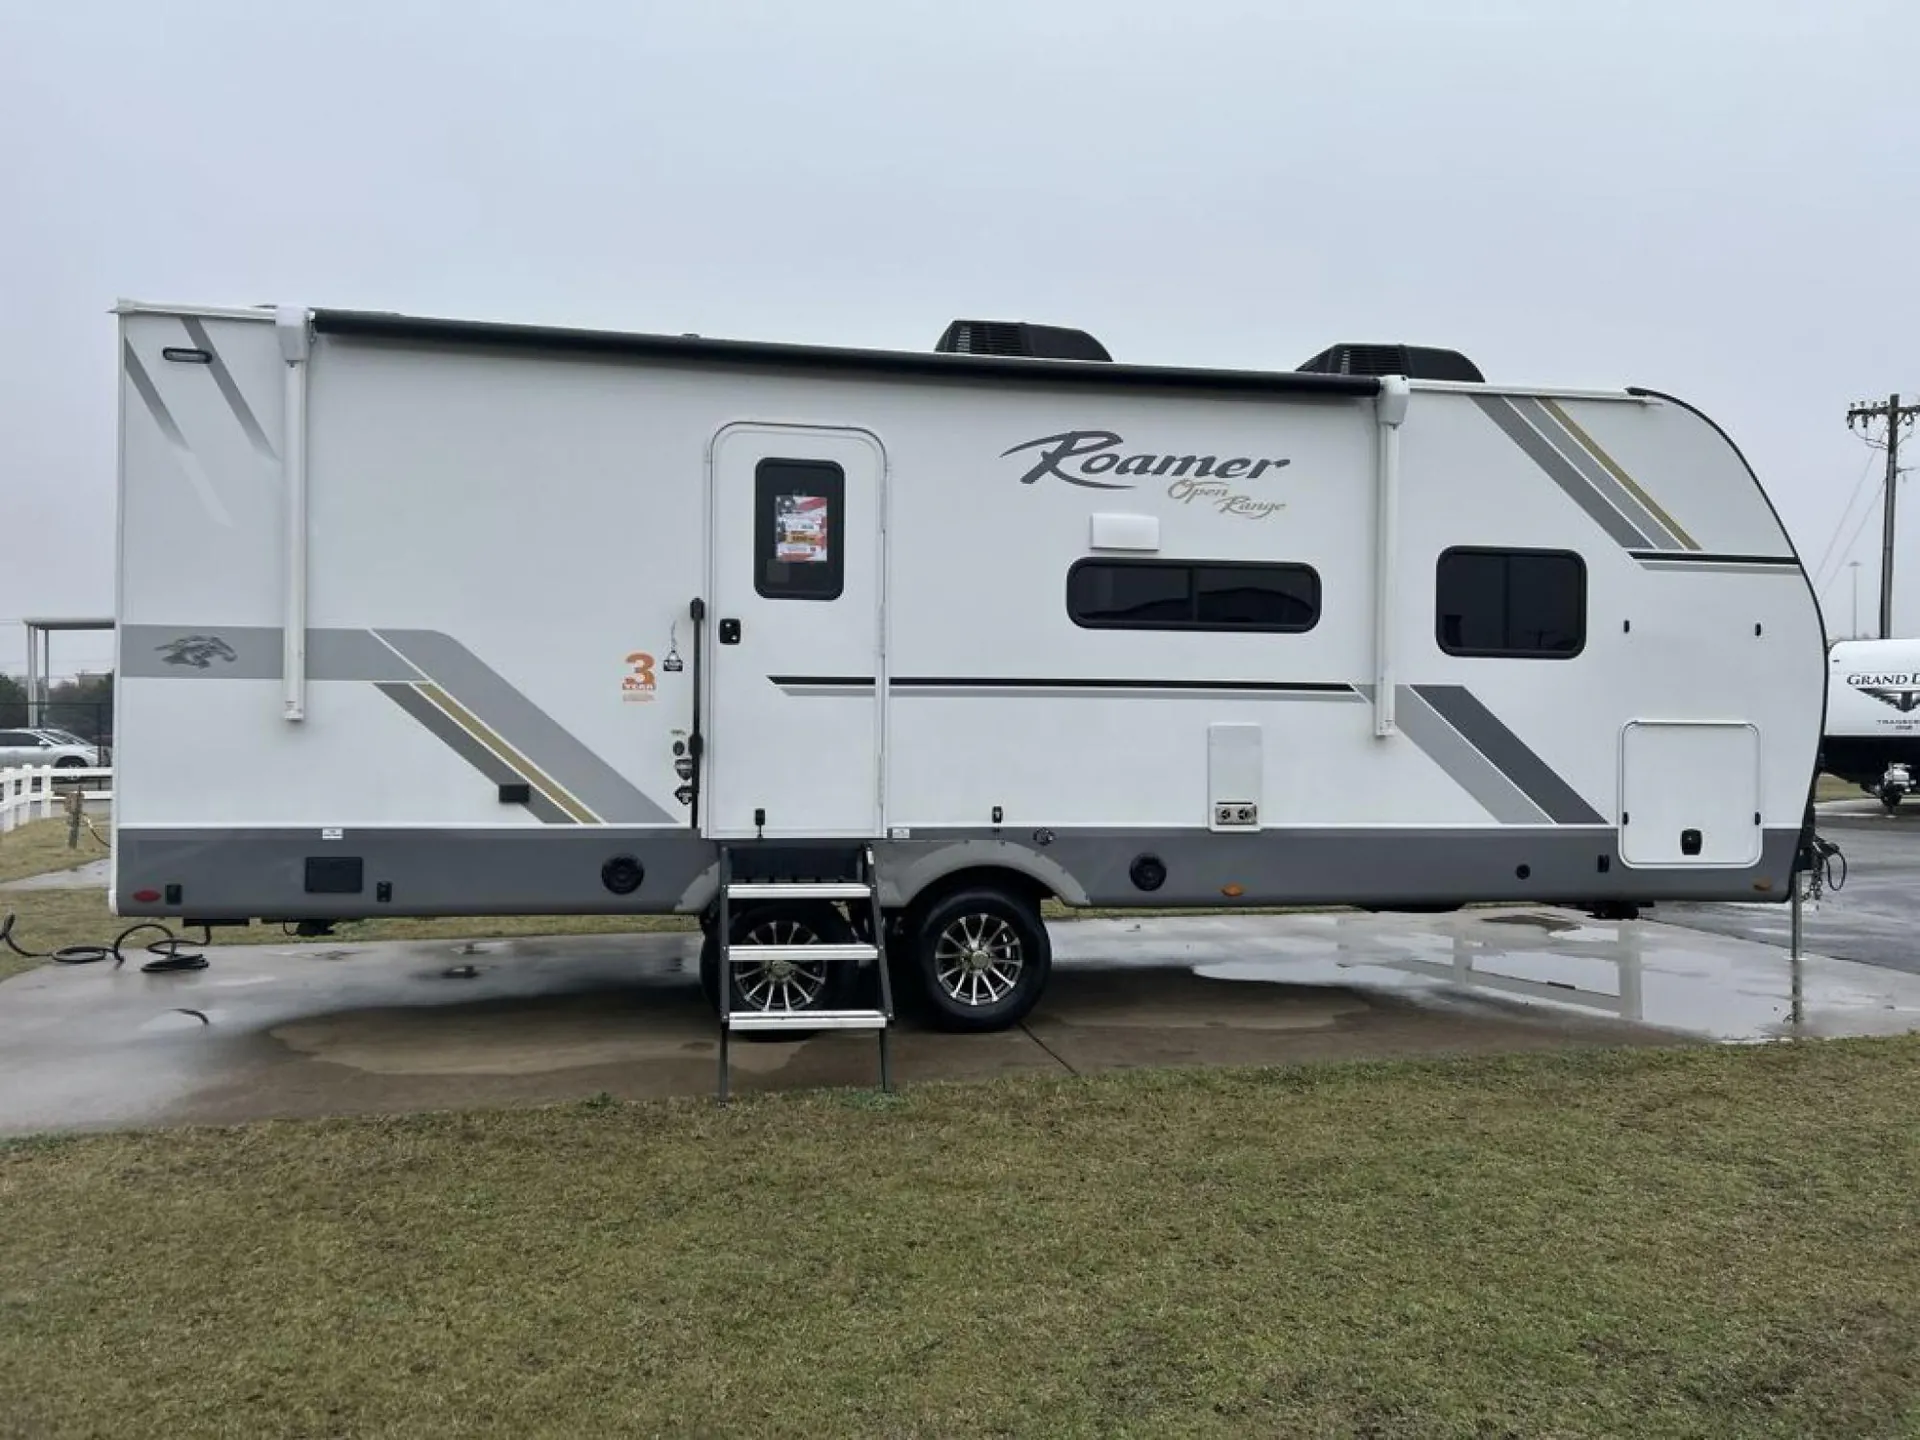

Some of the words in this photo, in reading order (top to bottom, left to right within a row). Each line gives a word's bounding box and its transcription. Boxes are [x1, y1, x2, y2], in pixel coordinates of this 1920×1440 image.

[1000, 430, 1291, 489] Roamer
[1167, 478, 1230, 504] Open
[1213, 496, 1286, 519] Range
[625, 652, 656, 685] 3
[1846, 674, 1908, 685] GRAND
